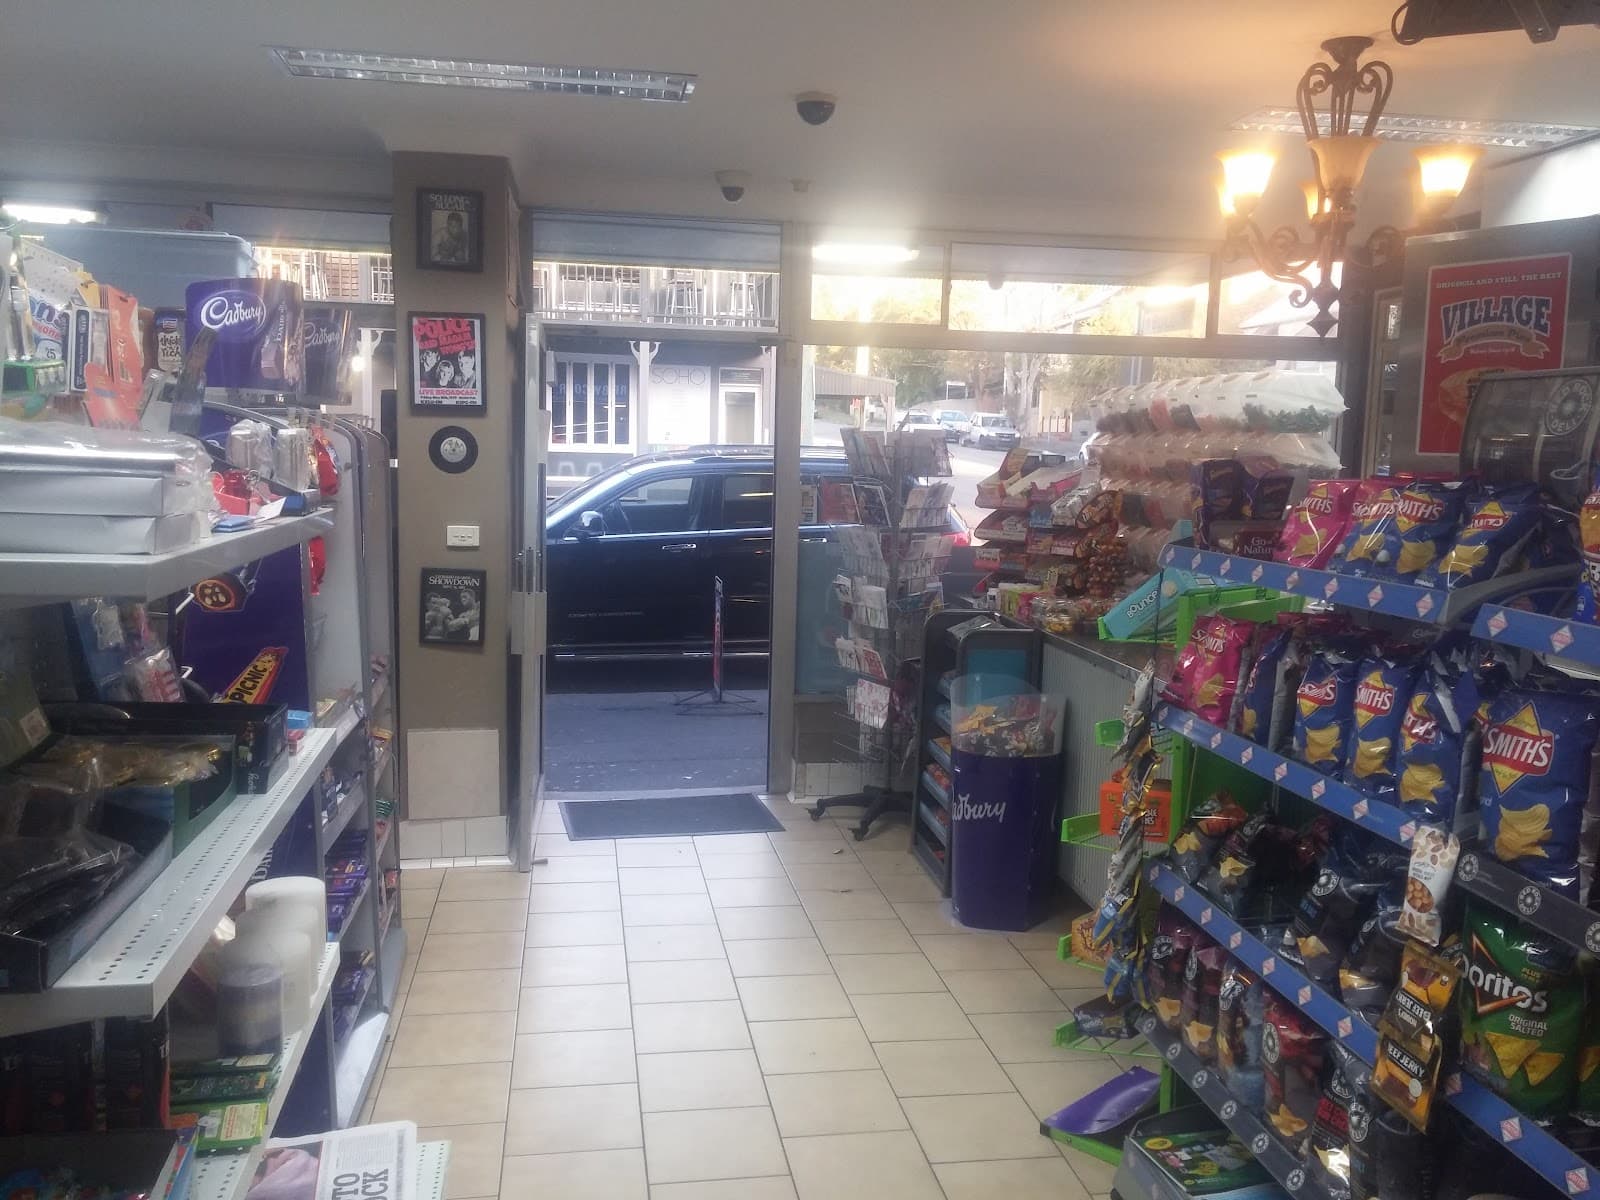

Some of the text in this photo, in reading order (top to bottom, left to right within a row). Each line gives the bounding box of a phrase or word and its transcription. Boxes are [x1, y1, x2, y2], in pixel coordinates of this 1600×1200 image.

[1475, 277, 1494, 285] AND
[201, 297, 263, 329] Cadbury
[1441, 295, 1552, 345] VILLAGE
[652, 368, 705, 385] SOHO
[1244, 546, 1274, 555] Natur
[428, 576, 480, 586] SHOWDOWN
[1483, 727, 1552, 767] SMITH'S
[952, 793, 1006, 823] adbury
[1508, 1013, 1548, 1031] ORIGINAL
[1510, 1023, 1544, 1037] SALTED
[1401, 1054, 1425, 1078] JERKY
